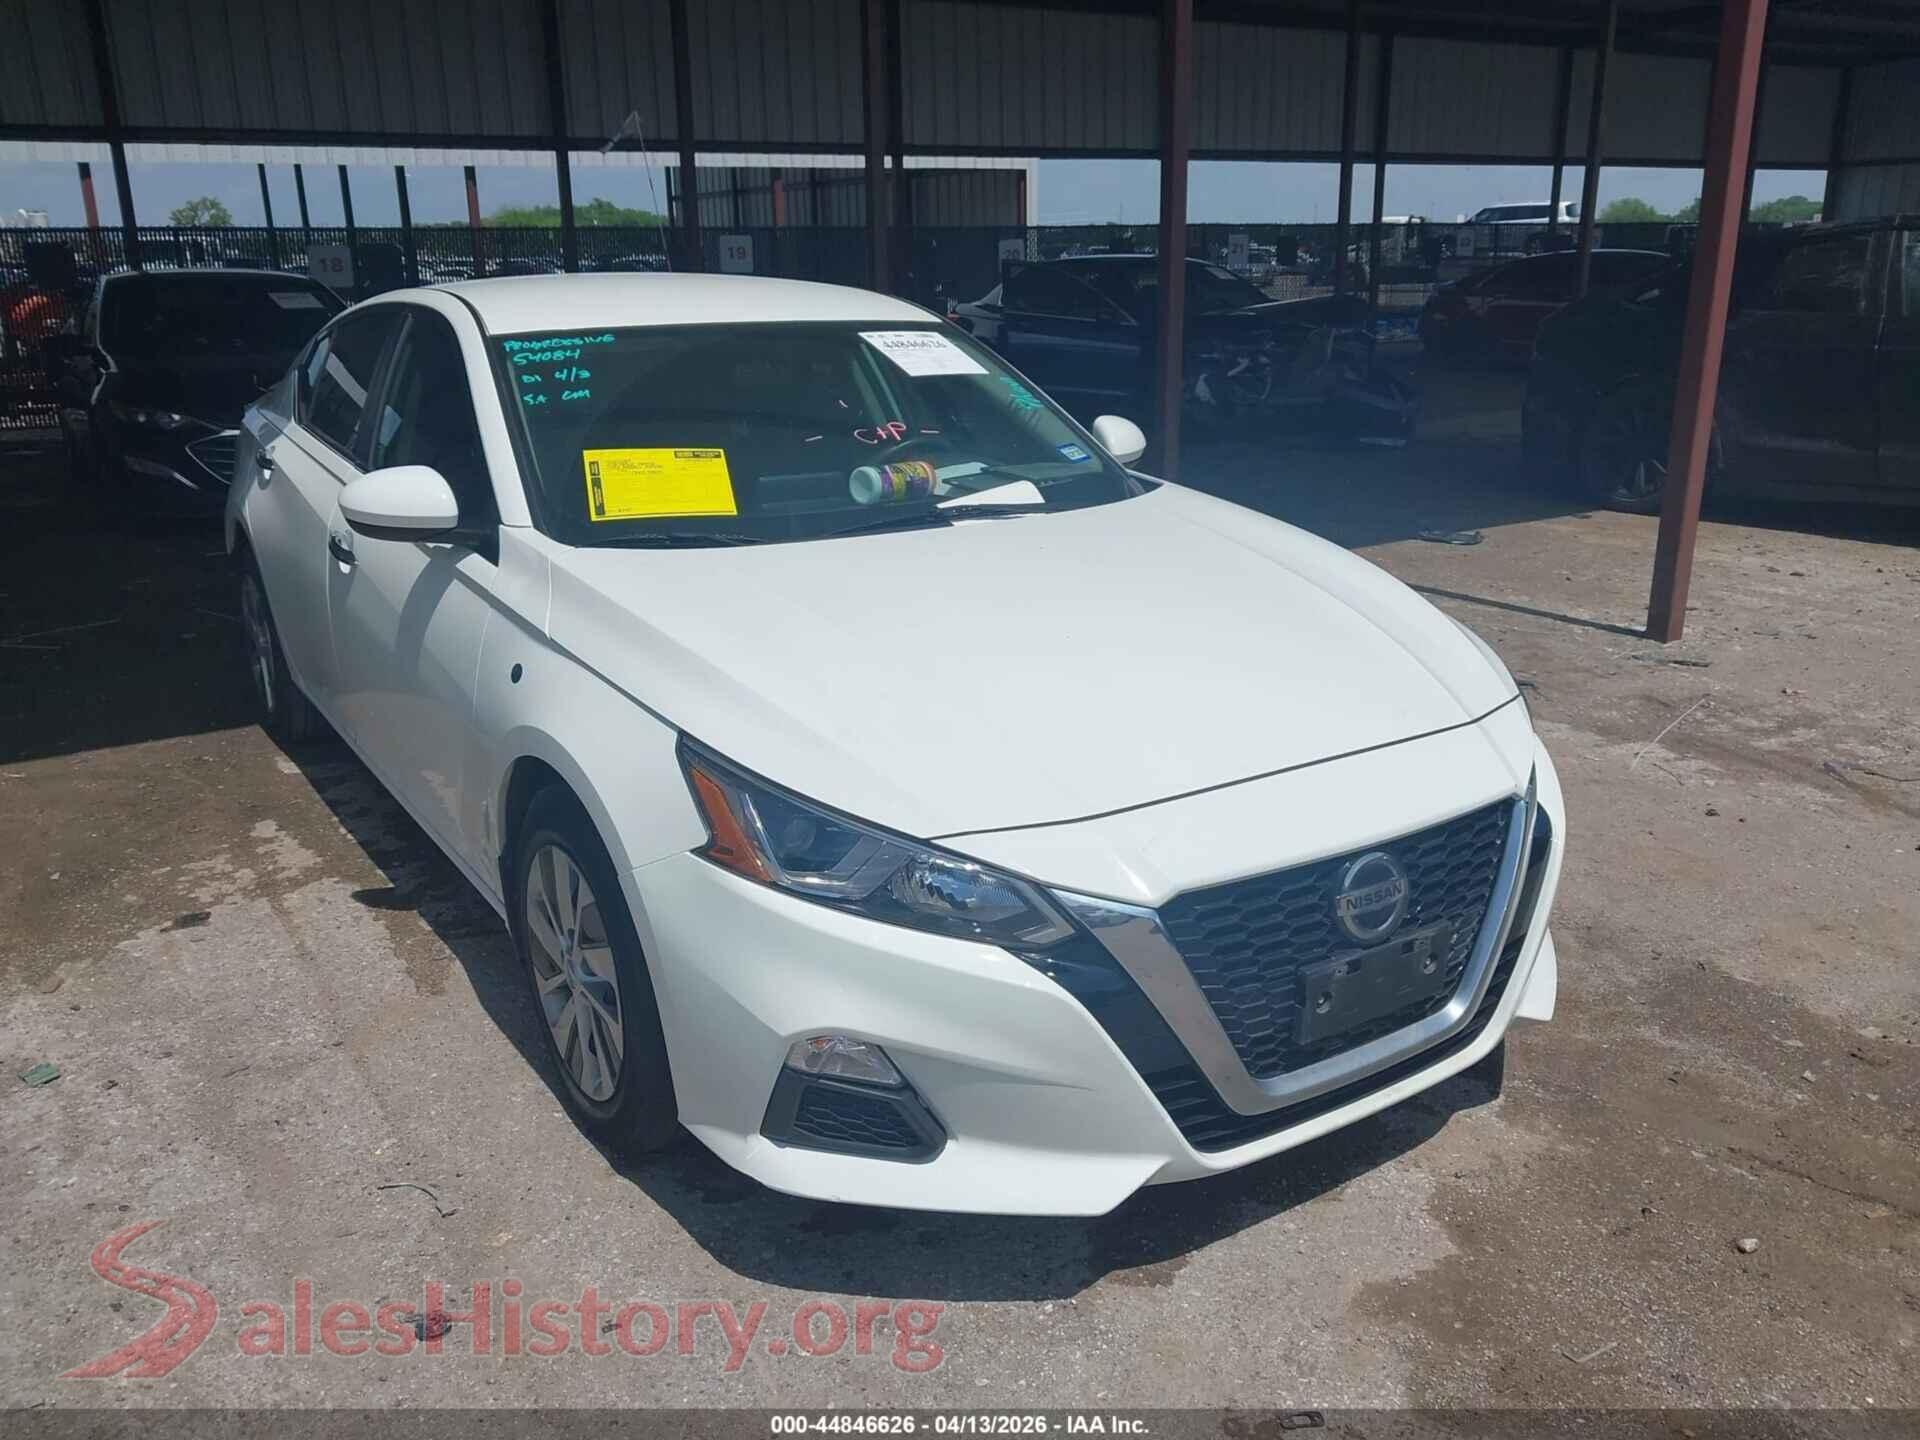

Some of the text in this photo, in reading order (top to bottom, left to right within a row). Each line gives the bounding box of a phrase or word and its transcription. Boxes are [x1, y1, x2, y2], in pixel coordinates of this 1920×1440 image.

[727, 247, 746, 259] 19
[319, 257, 345, 272] 18
[1345, 879, 1402, 911] NISSAN
